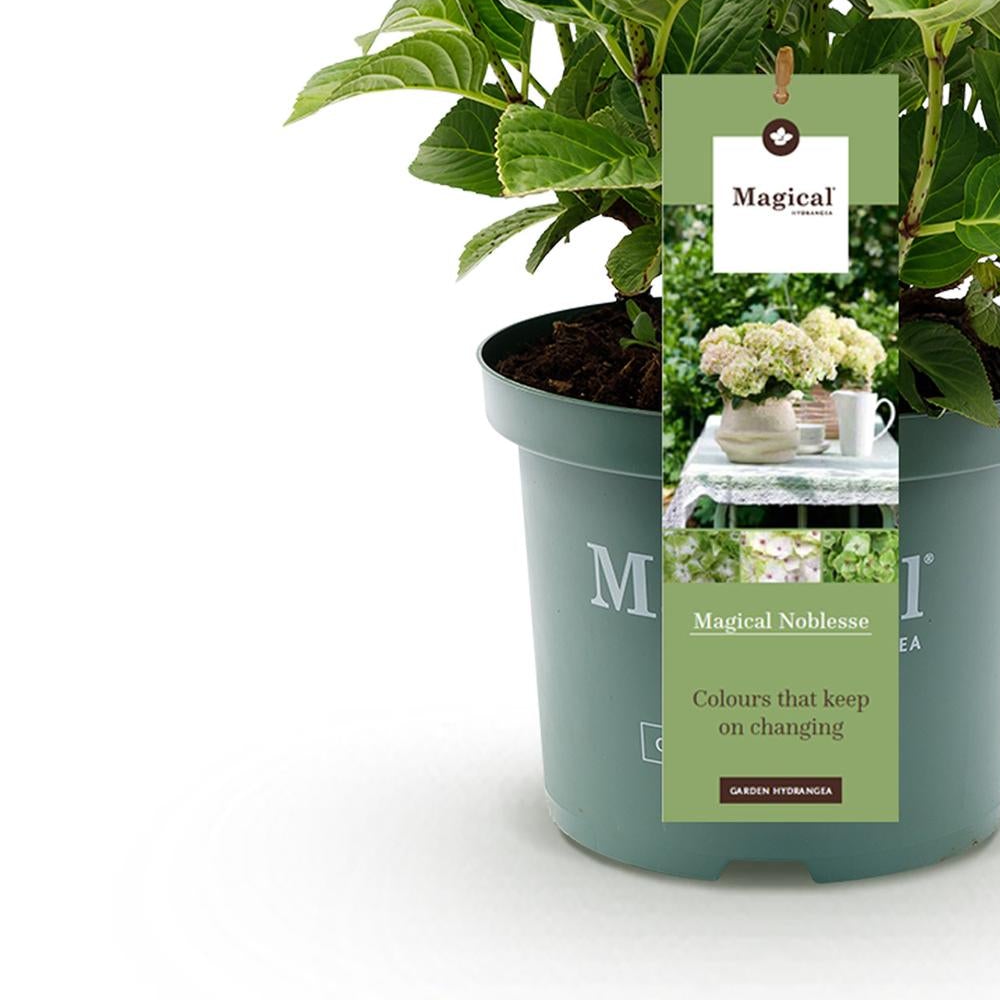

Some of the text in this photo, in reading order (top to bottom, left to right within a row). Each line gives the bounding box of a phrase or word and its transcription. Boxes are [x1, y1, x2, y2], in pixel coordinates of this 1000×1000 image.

[693, 611, 870, 633] Magical Noblesse
[692, 689, 870, 713] Colours that keep
[718, 716, 844, 741] on changing
[729, 786, 833, 796] GARDEN HYDRANGEA
